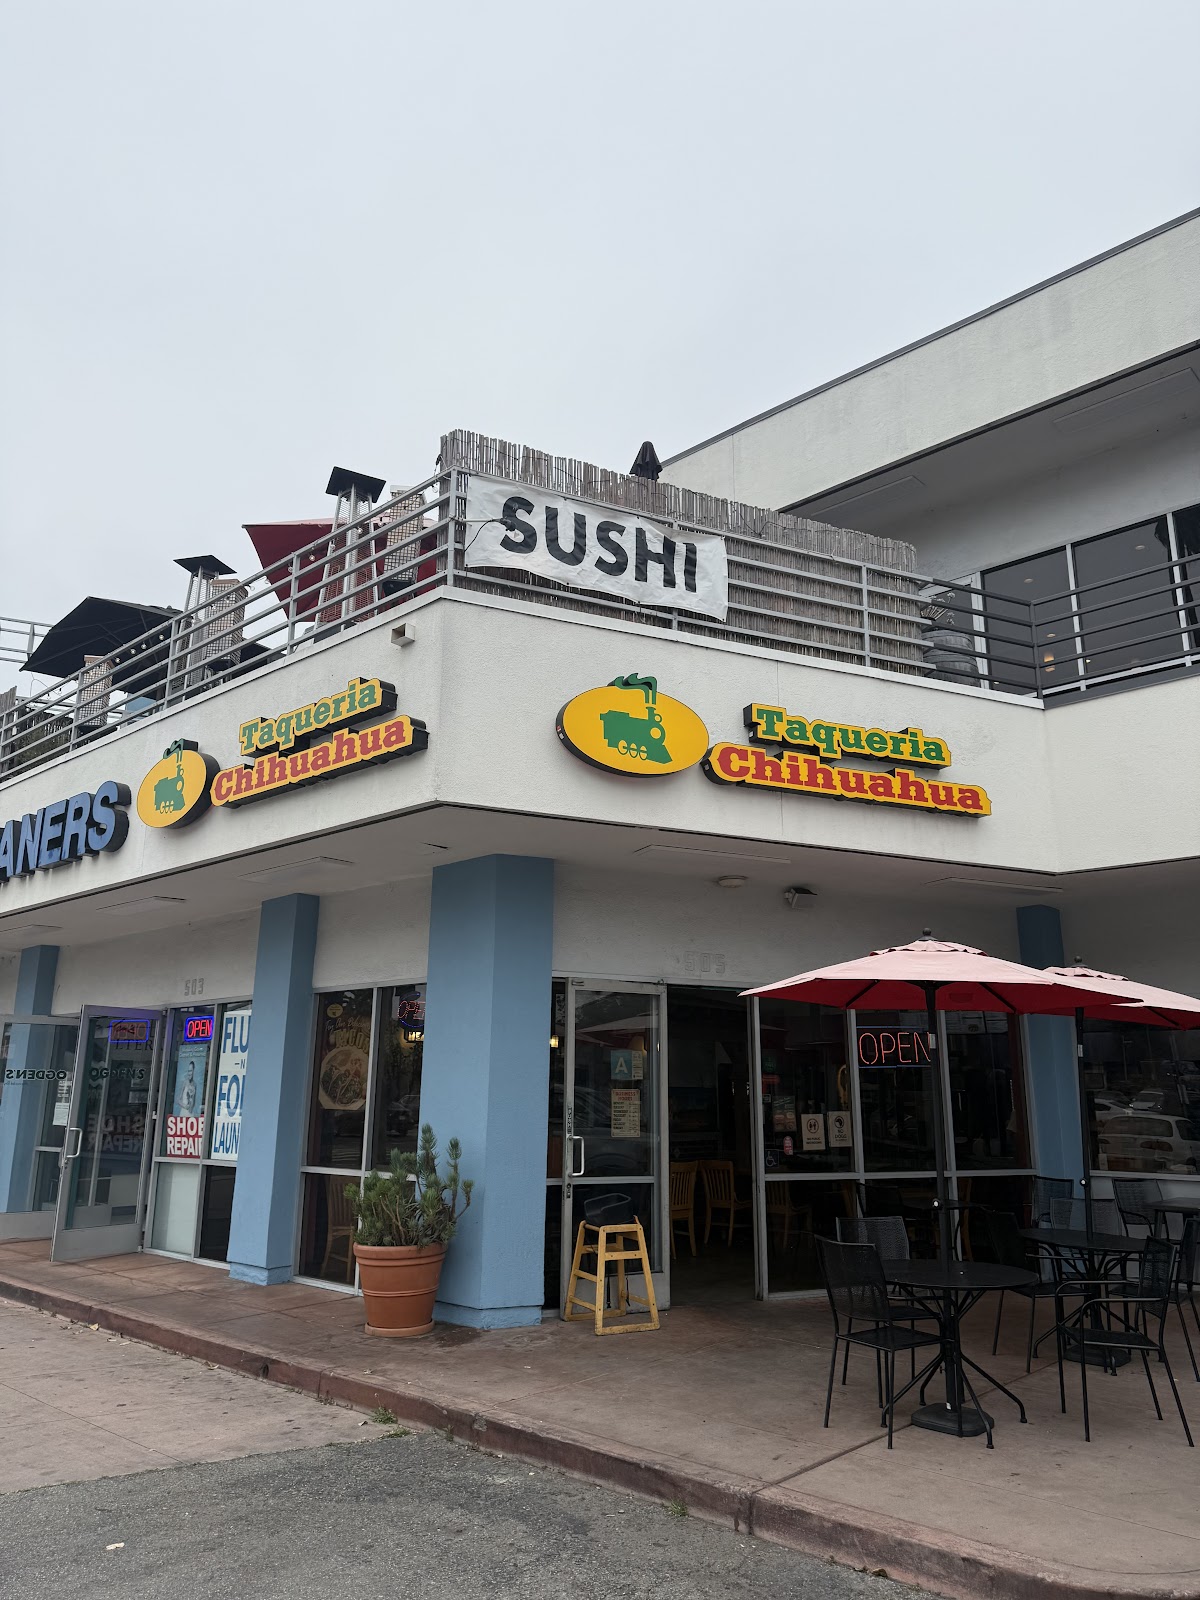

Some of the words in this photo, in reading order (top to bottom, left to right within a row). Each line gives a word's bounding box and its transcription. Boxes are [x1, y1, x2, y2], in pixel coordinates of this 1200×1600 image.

[499, 496, 698, 593] SUSHI
[241, 683, 377, 752] Taqueria
[755, 707, 948, 762] Taqueria
[214, 719, 407, 801] Chihuahua
[716, 745, 984, 811] Chihuahua
[684, 950, 725, 974] 505
[184, 977, 205, 996] 503
[398, 1000, 426, 1020] OPE
[187, 1018, 213, 1038] OPEN
[858, 1031, 932, 1065] OPEN
[614, 1056, 629, 1074] A
[167, 1116, 204, 1136] SHOE
[213, 1122, 241, 1154] LAUN
